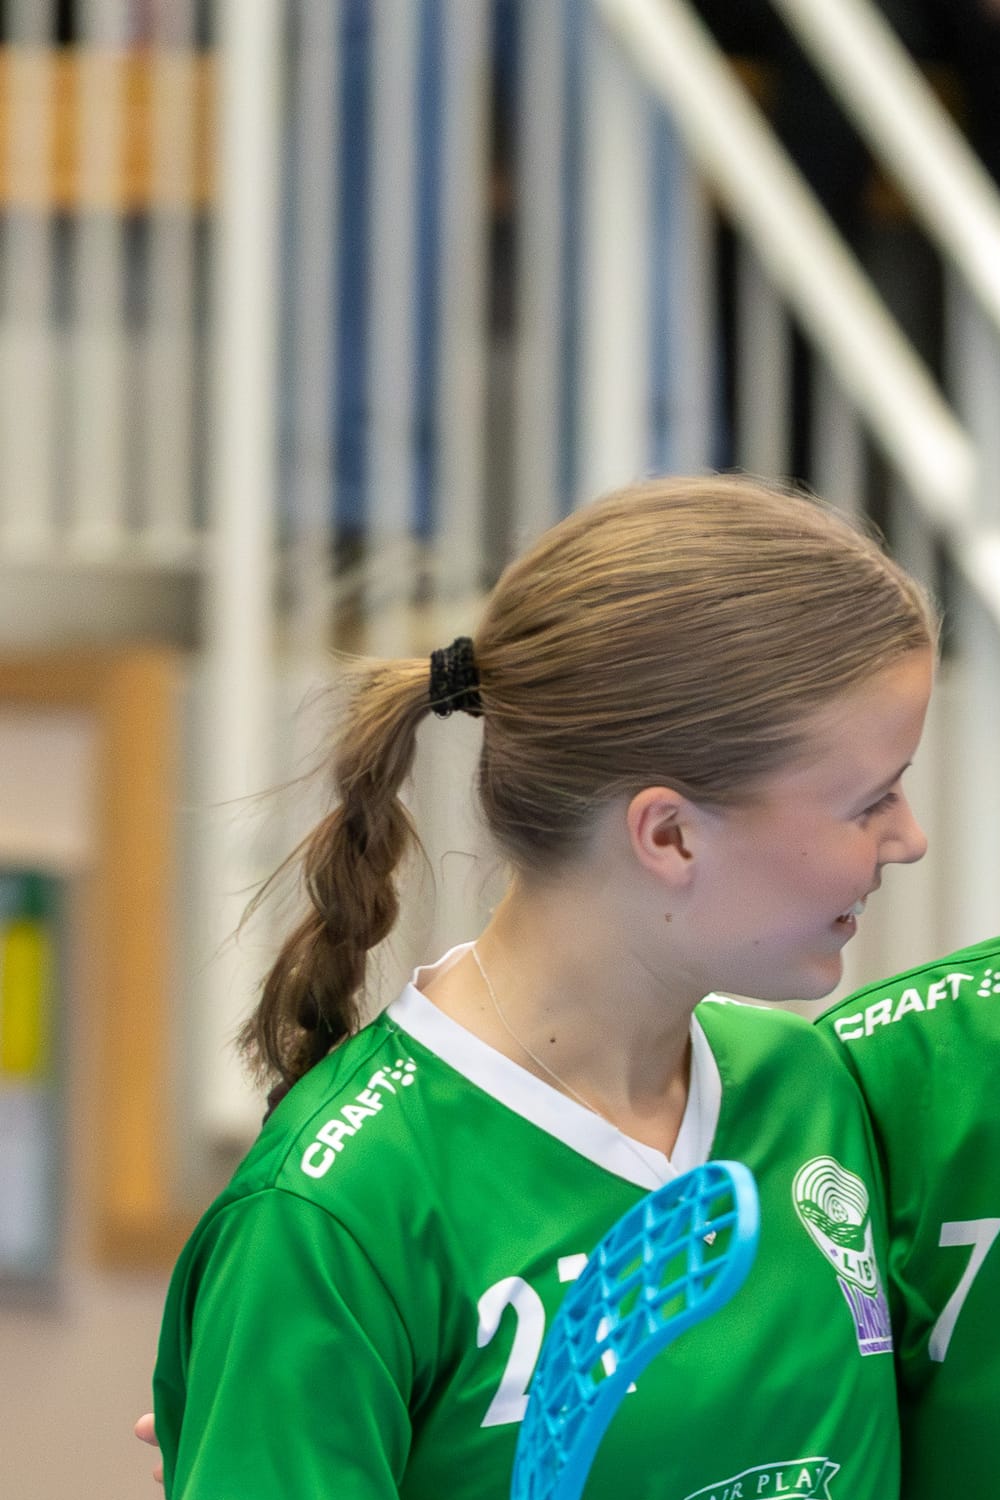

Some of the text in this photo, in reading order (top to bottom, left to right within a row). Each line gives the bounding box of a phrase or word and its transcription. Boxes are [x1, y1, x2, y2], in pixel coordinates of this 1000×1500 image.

[834, 972, 974, 1042] CRAFT
[300, 1068, 397, 1179] CRAFT
[756, 1467, 826, 1494] PLA
